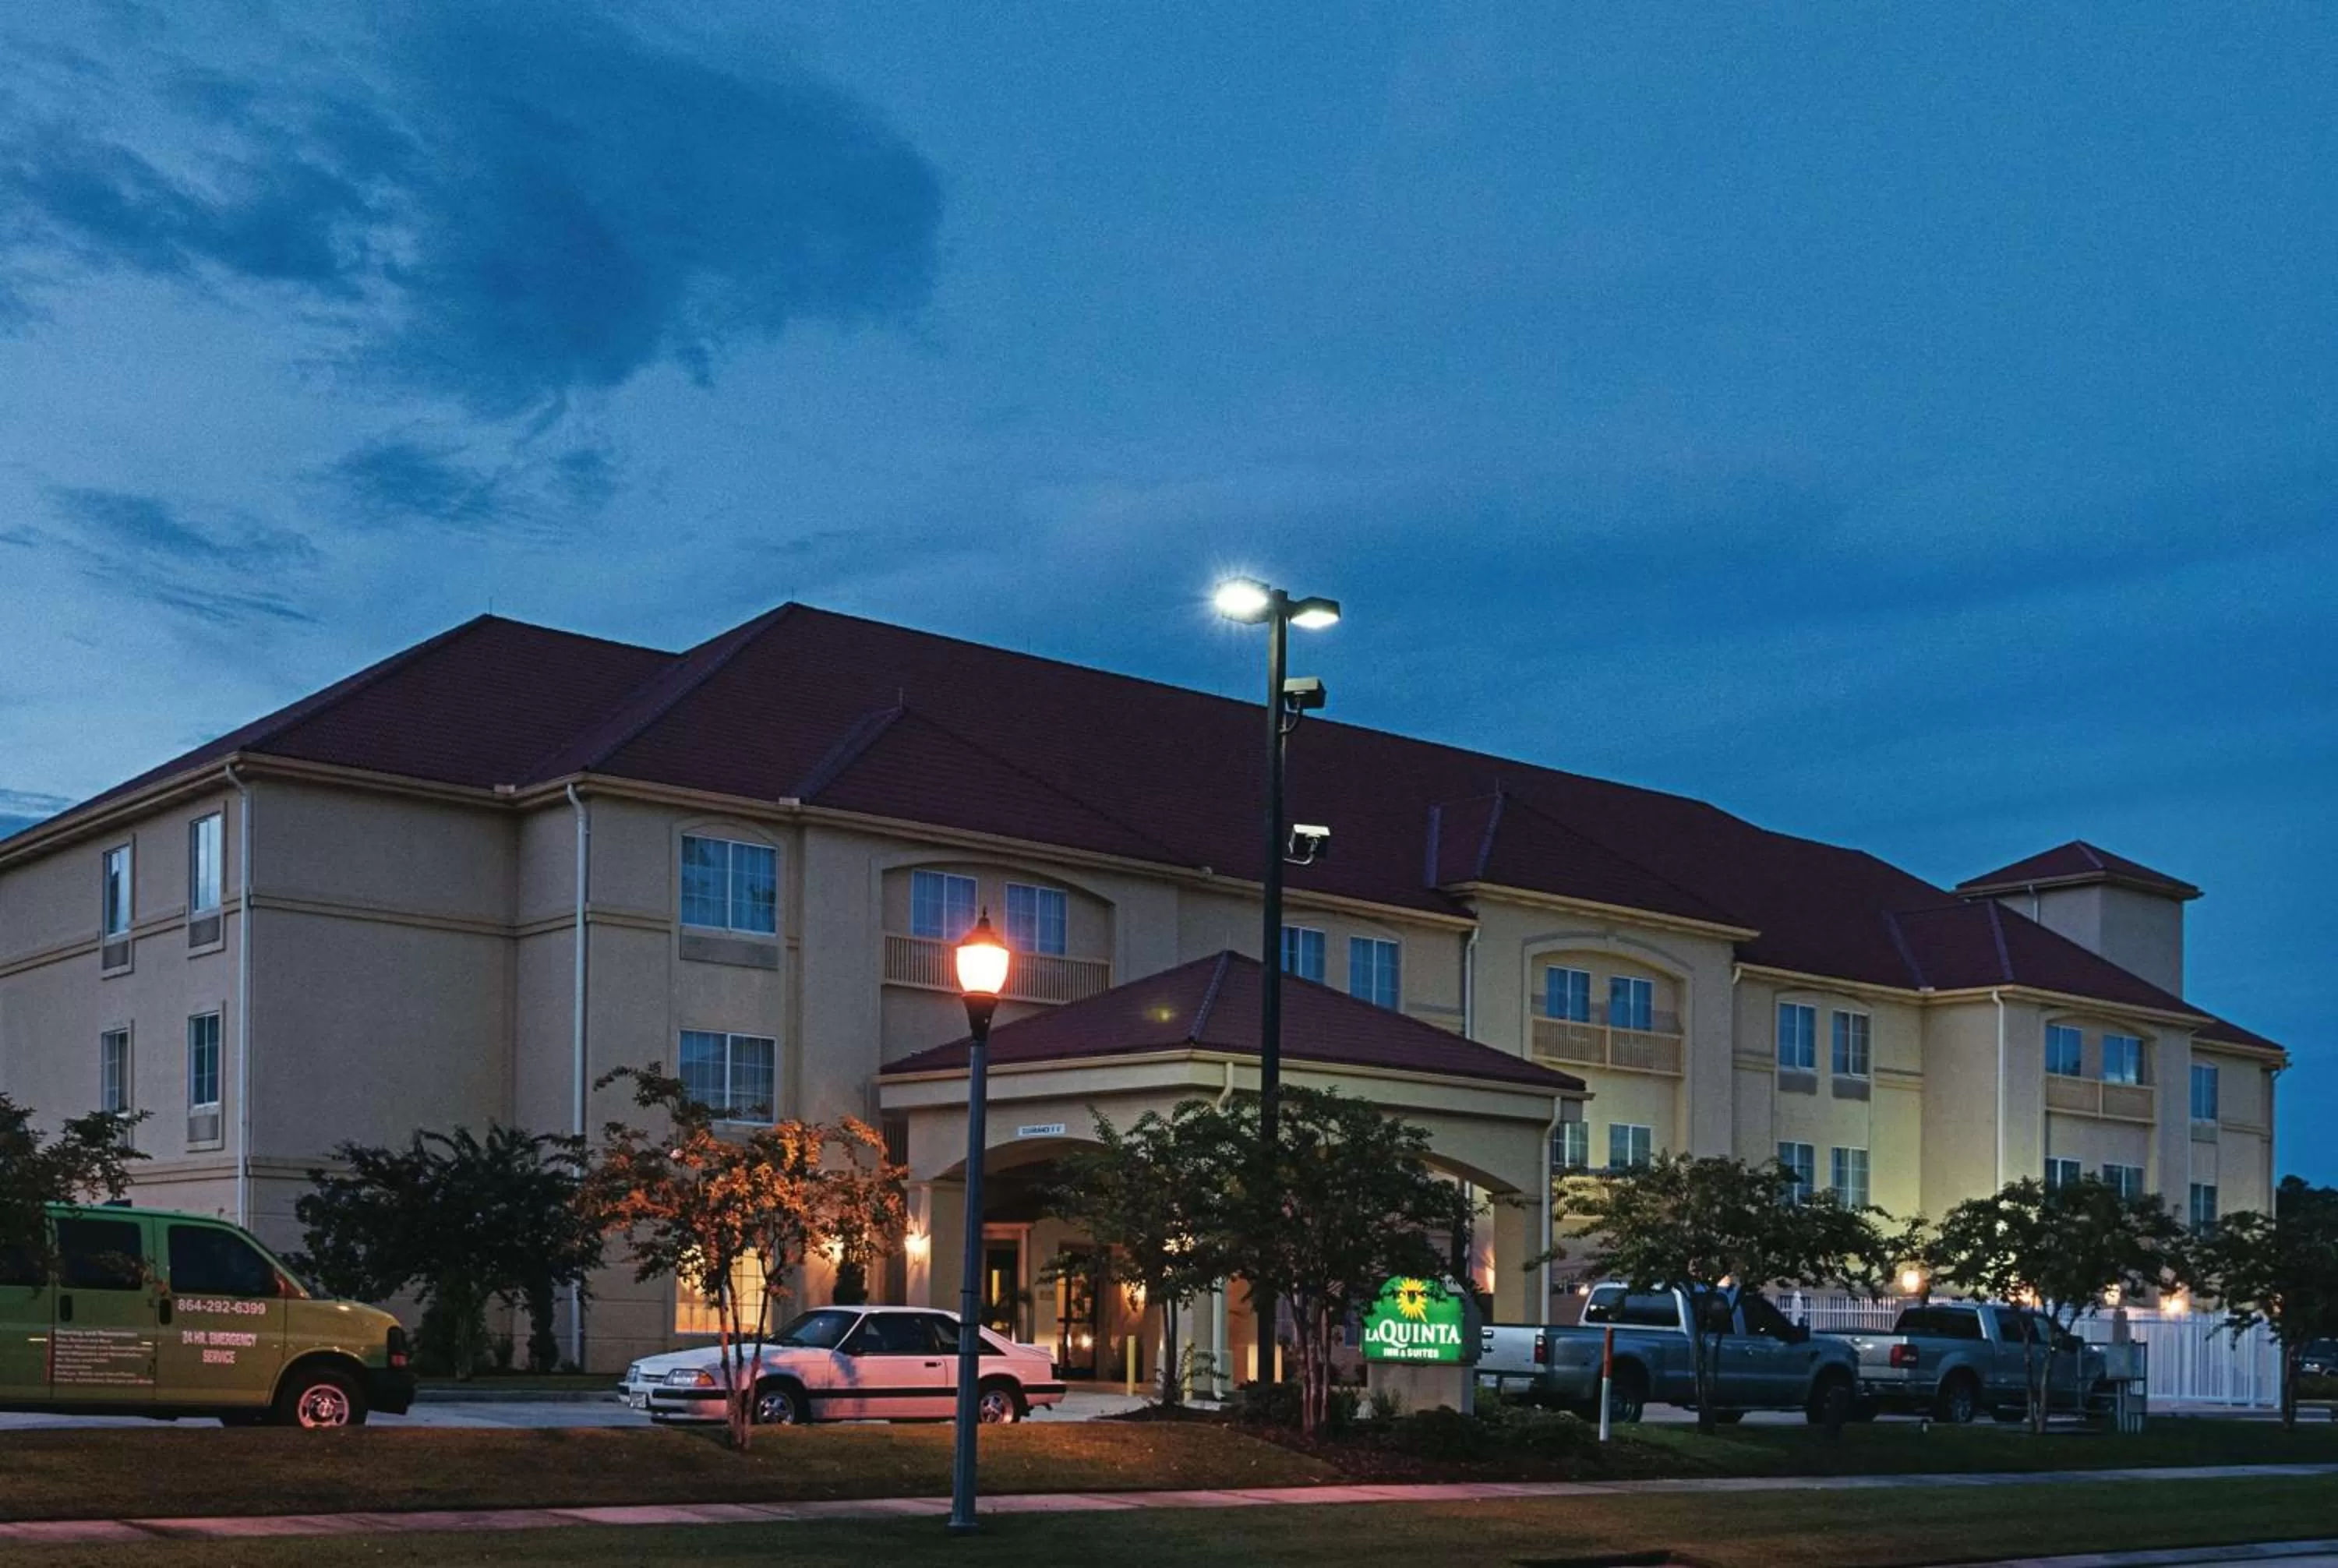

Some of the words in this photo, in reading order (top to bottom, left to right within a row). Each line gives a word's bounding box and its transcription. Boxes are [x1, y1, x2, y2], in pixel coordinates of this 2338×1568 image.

[178, 1298, 267, 1315] 864-292-6399
[208, 1331, 257, 1347] EMERGENCY
[1379, 1319, 1461, 1347] QUINTA
[202, 1349, 236, 1365] SERVICE
[1383, 1347, 1400, 1358] INN
[1401, 1349, 1407, 1358] &
[1407, 1347, 1439, 1359] SUITES
